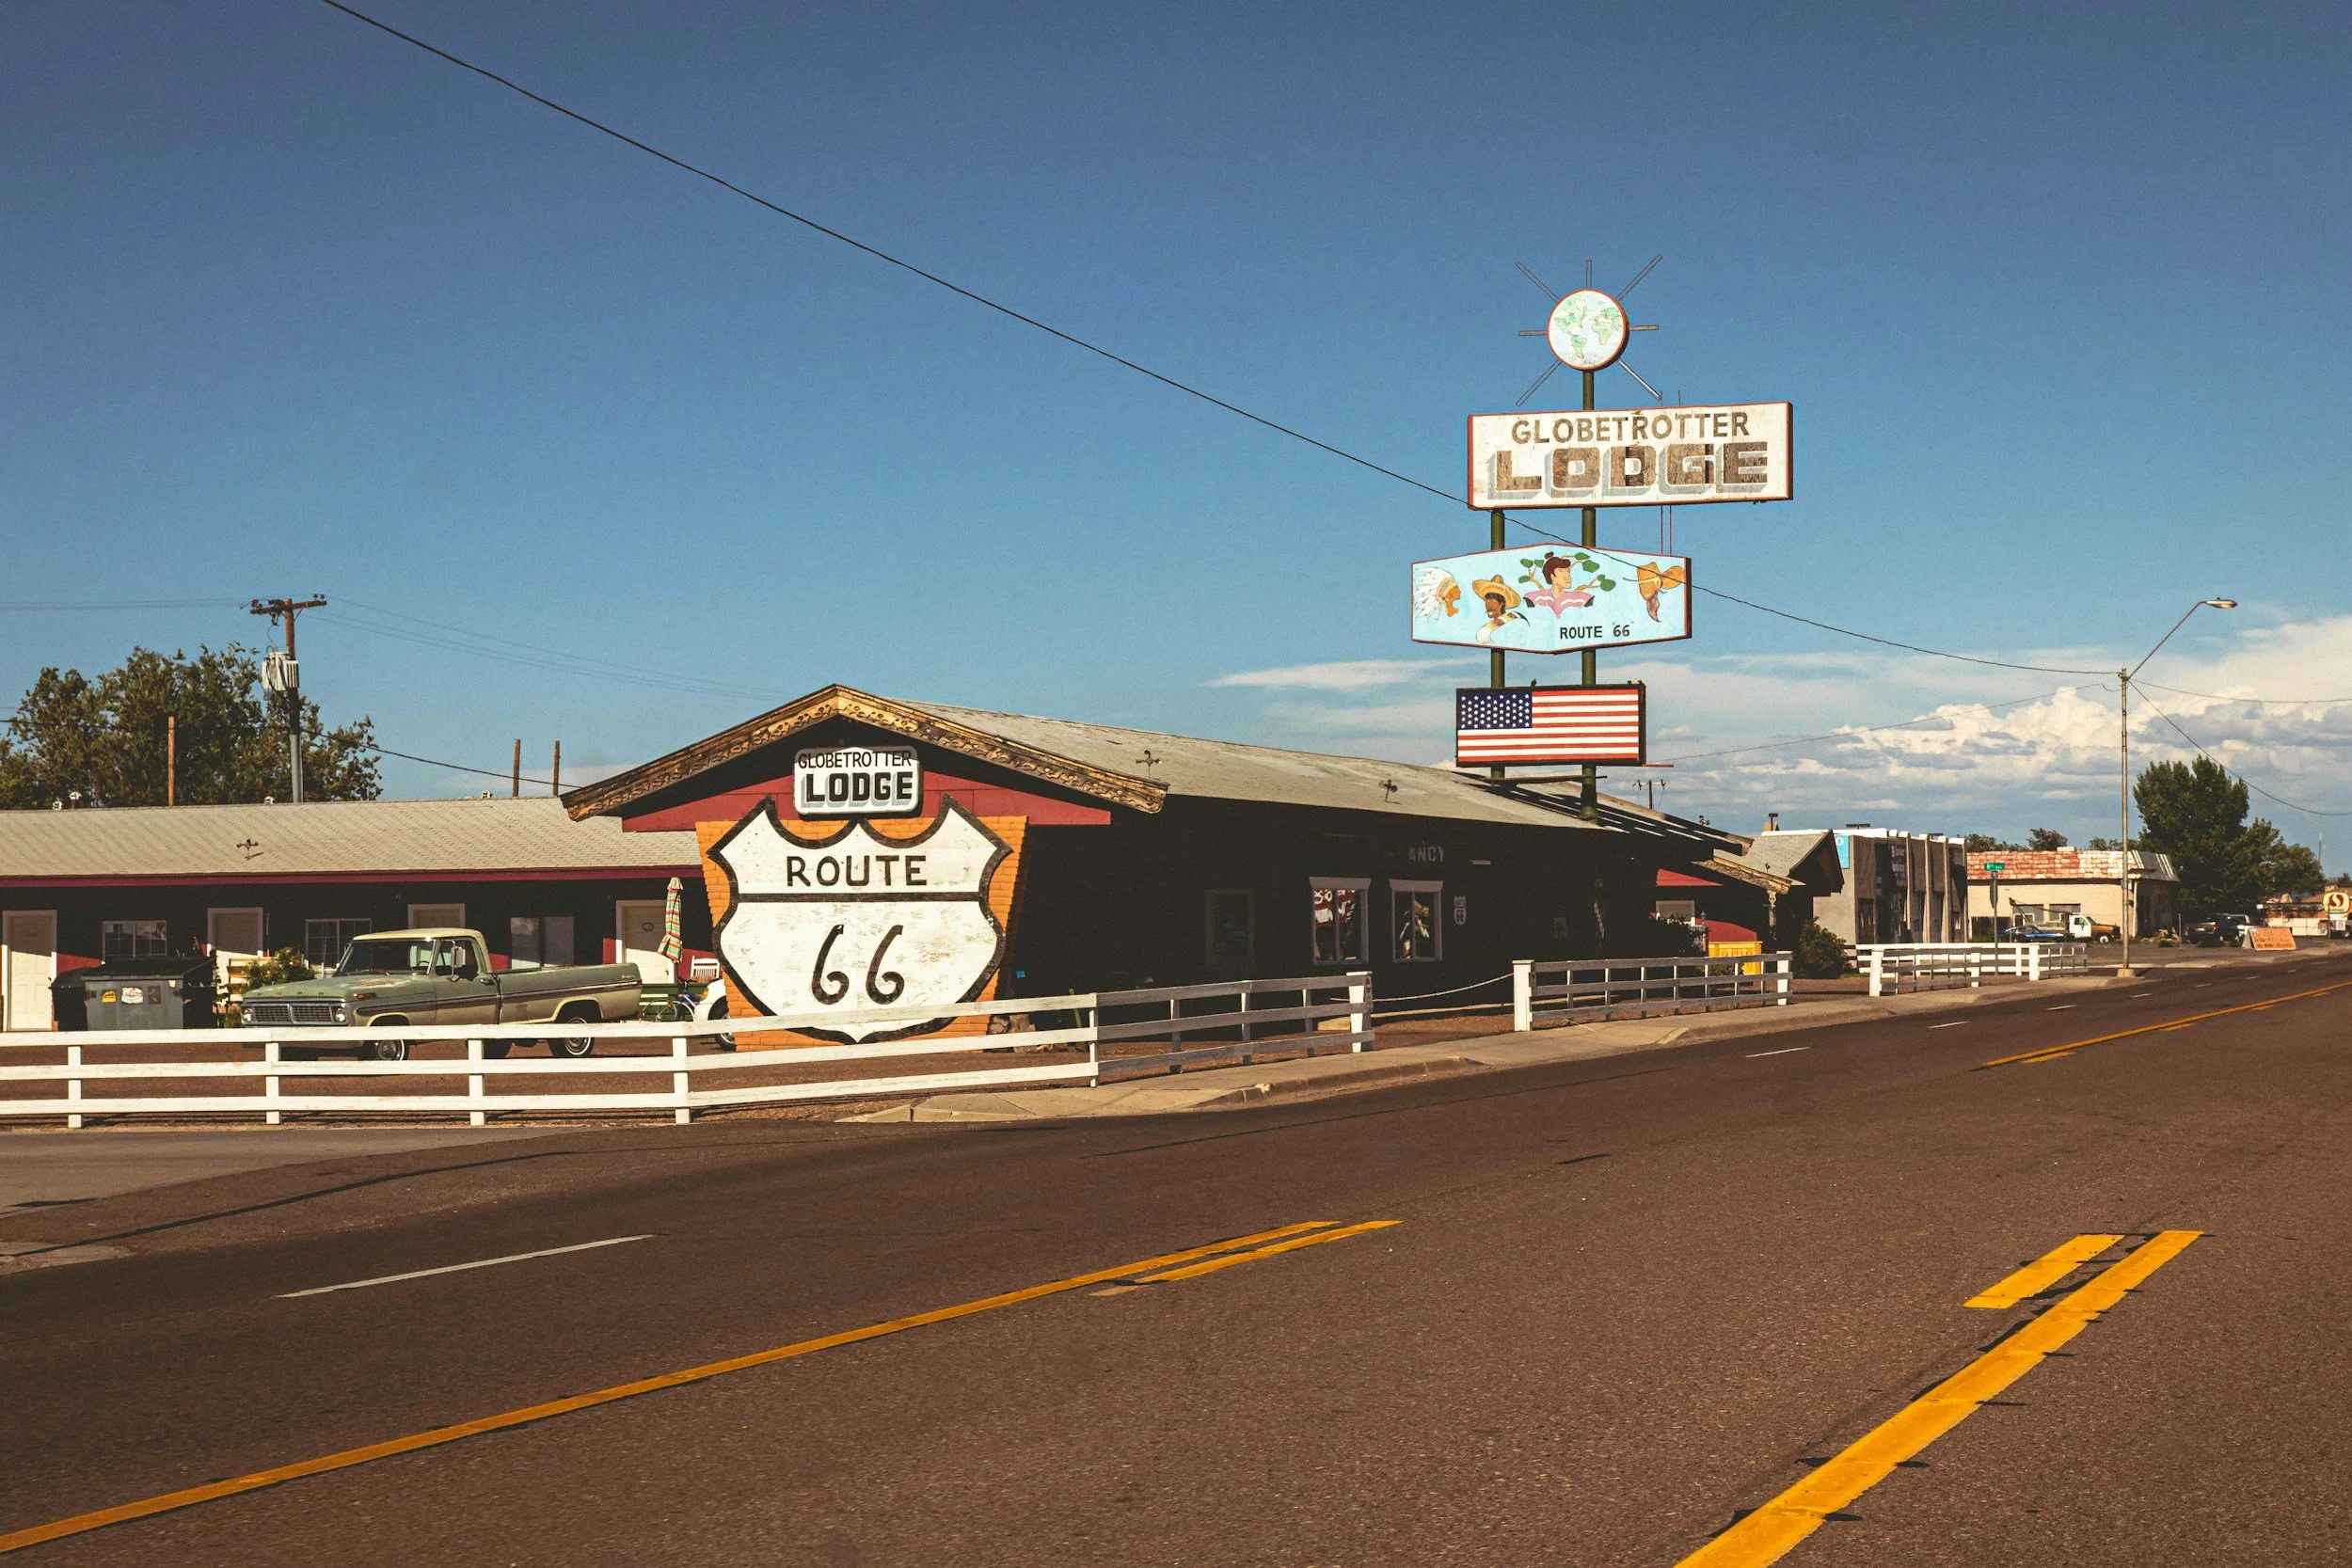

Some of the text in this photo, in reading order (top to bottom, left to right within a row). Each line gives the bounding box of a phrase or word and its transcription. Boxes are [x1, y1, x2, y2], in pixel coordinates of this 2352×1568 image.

[1511, 412, 1751, 445] GLOBETROTTER
[1494, 441, 1769, 494] LODGE
[1560, 626, 1603, 640] ROUTE
[798, 750, 912, 768] GLOBETROTTER
[805, 771, 914, 802] LODGE
[786, 854, 928, 888] ROUTE
[811, 924, 905, 1006] 66
